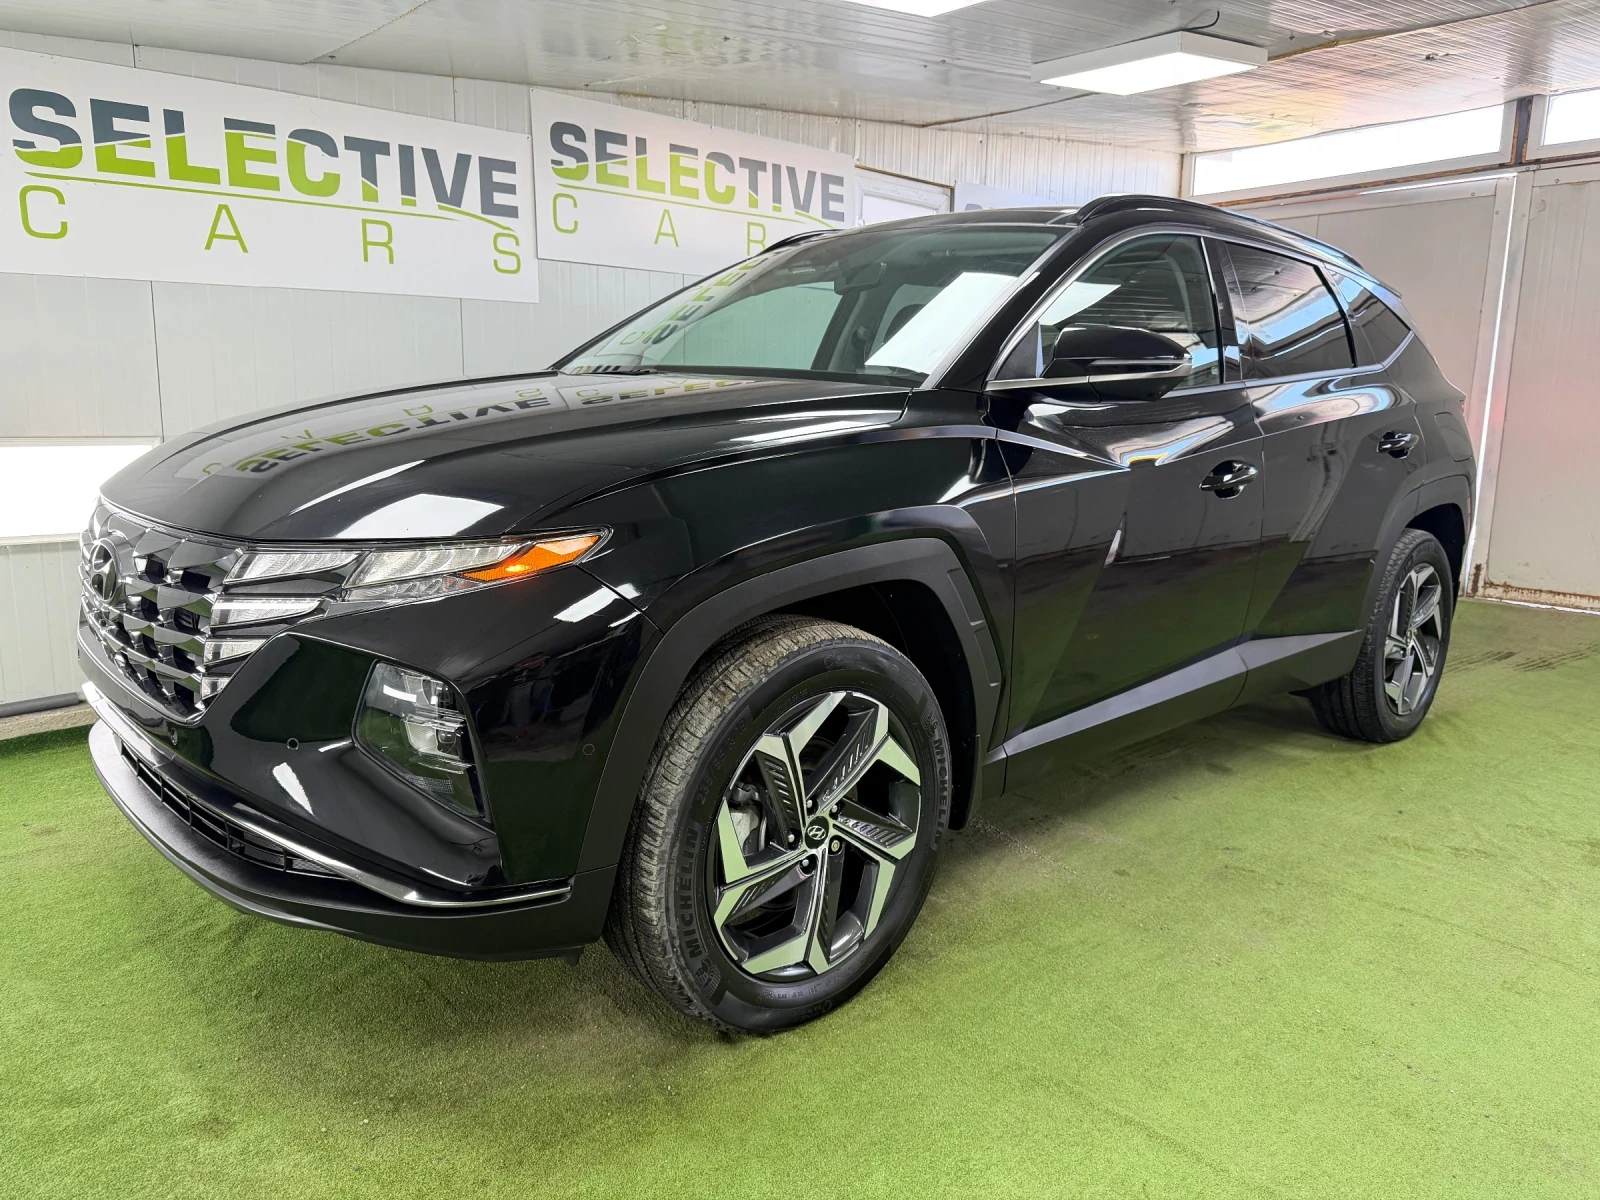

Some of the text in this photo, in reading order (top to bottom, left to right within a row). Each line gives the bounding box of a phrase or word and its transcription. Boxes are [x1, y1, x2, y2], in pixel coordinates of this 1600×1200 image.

[9, 88, 519, 219] SELECTIVE
[550, 121, 845, 222] SELECTIVE
[19, 184, 521, 275] CARS
[552, 193, 767, 257] CAR
[932, 737, 949, 848] MICHELIN
[679, 826, 702, 959] MICHELIN
